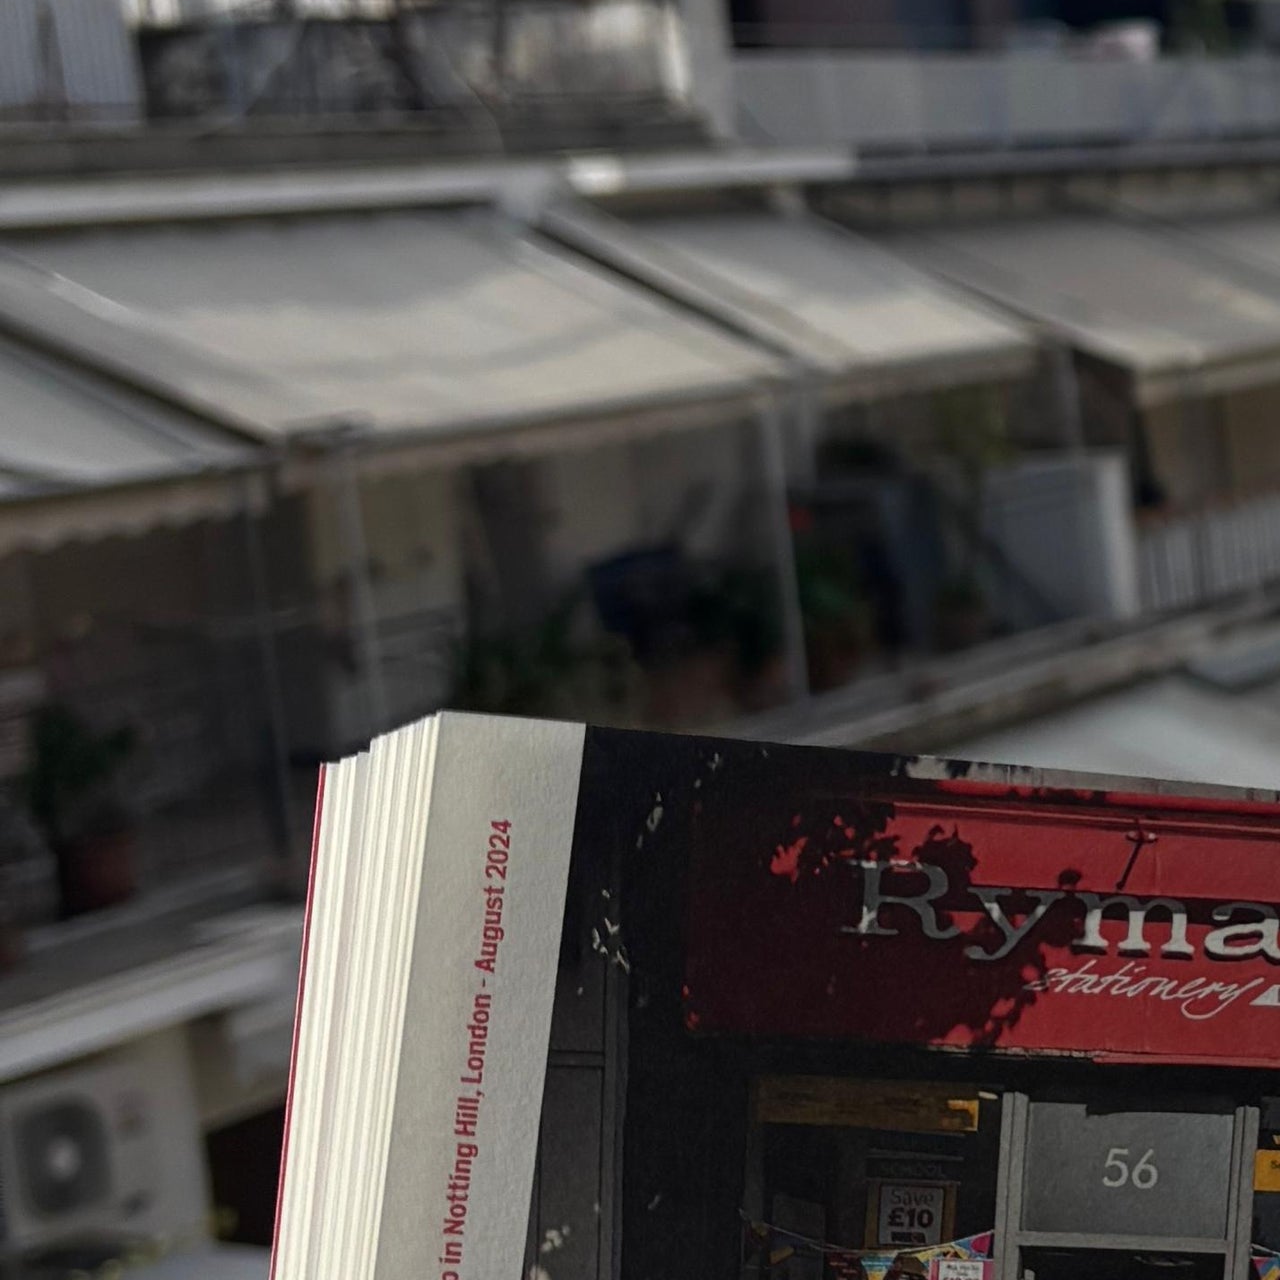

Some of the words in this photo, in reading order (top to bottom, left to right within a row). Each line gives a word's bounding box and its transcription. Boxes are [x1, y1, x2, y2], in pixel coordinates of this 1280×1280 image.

[485, 819, 512, 880] 2024
[474, 885, 505, 974] August
[1024, 959, 1265, 1020] stationery
[461, 992, 491, 1084] London
[454, 1089, 485, 1137] Hill,
[443, 1141, 478, 1236] Notting
[1102, 1147, 1158, 1189] 56
[888, 1207, 934, 1228] £10
[891, 1189, 934, 1206] Save
[438, 1240, 462, 1265] in
